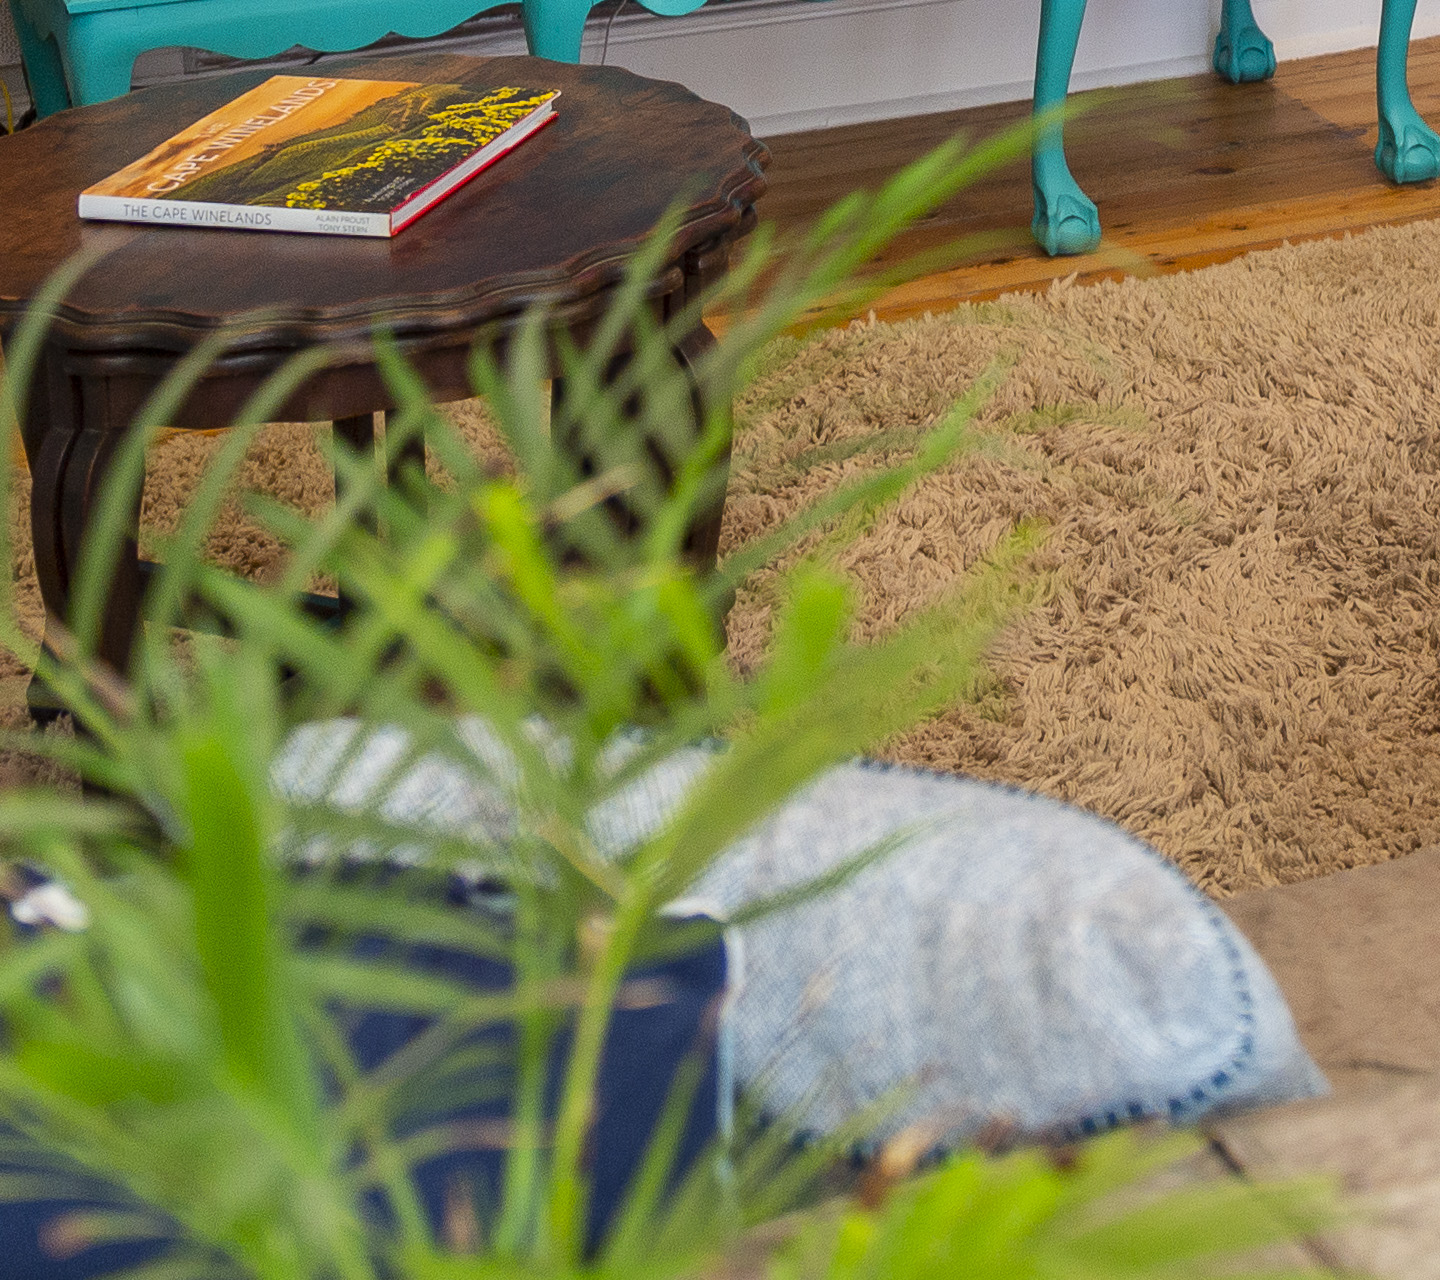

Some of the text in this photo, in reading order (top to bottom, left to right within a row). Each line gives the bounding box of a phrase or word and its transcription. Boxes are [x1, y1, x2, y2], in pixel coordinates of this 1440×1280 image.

[147, 79, 337, 192] CAPE WINELANDS
[123, 203, 273, 226] THE CAPE WINELANDS
[318, 223, 341, 232] TONY
